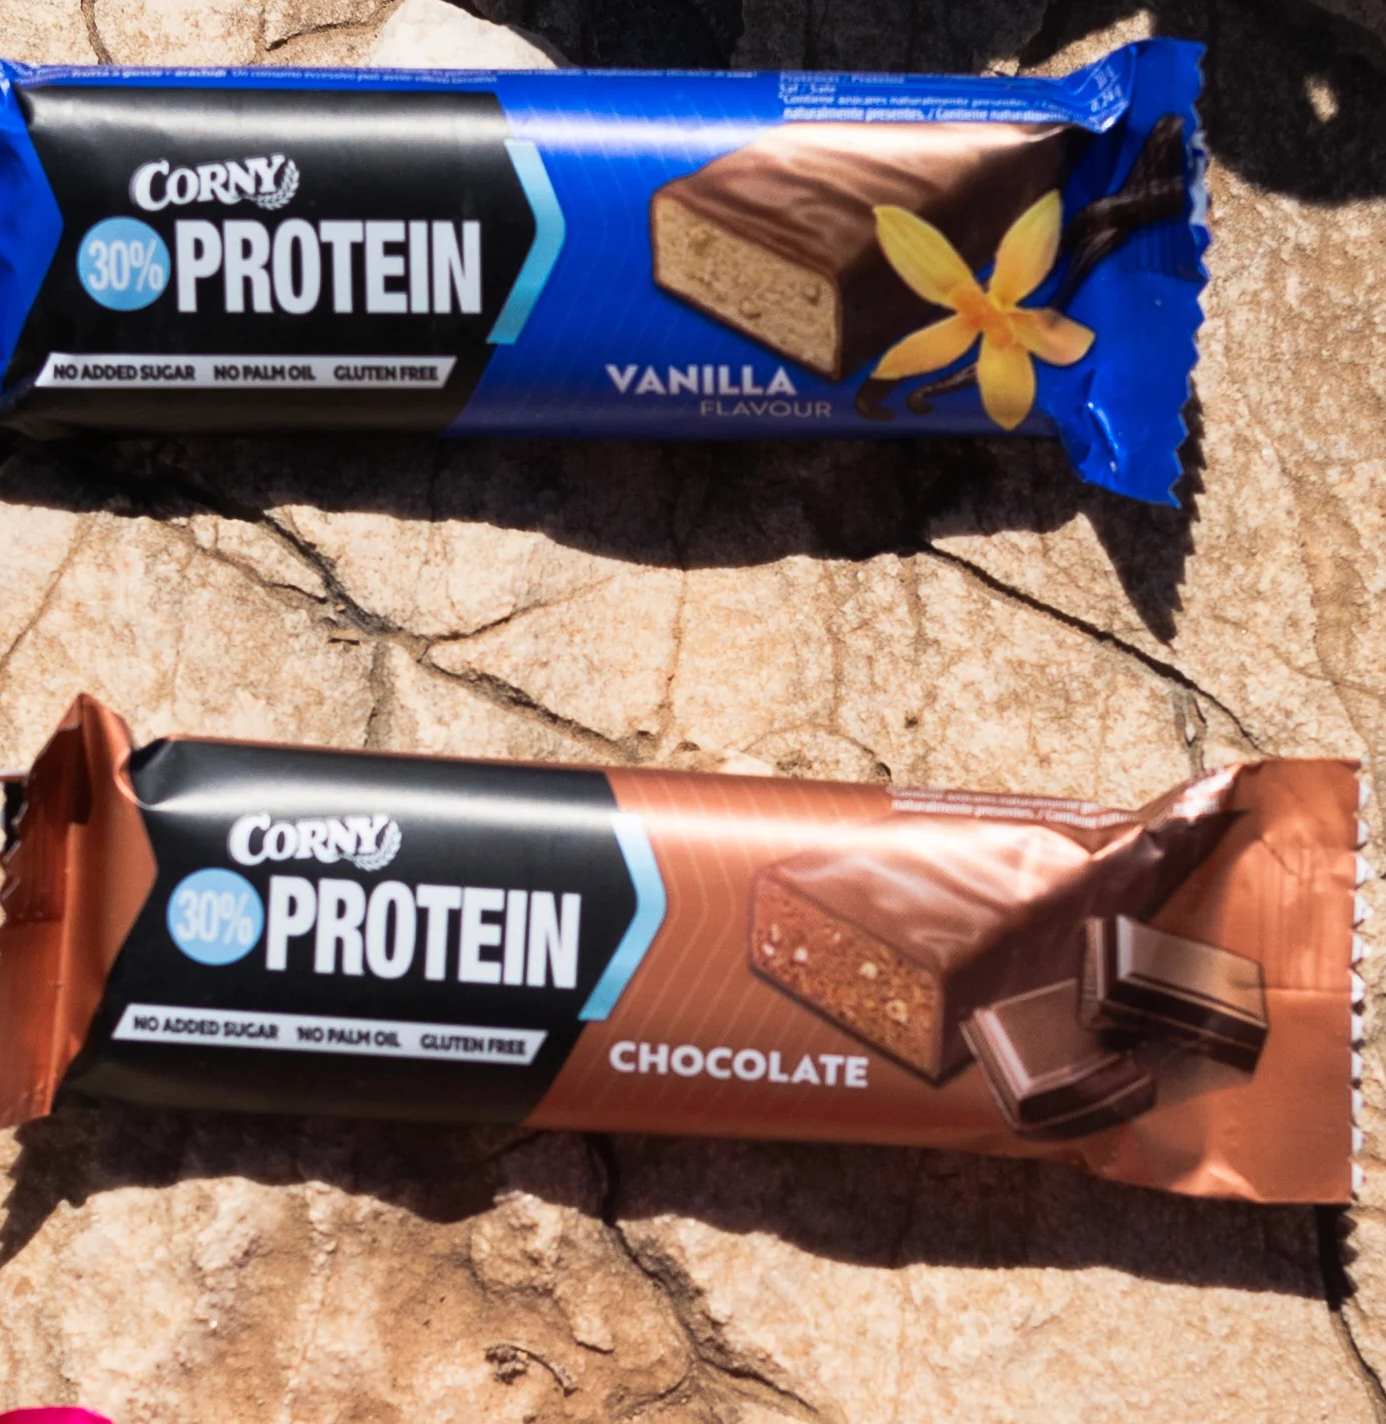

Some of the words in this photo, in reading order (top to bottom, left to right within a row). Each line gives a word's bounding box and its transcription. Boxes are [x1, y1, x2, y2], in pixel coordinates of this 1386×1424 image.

[130, 153, 288, 211] CORNY
[87, 239, 164, 292] 30%
[174, 217, 483, 315] PROTEIN
[53, 364, 79, 381] NO
[81, 364, 139, 382] ADDED
[140, 364, 196, 382] SUGAR
[213, 365, 236, 382] NO
[237, 365, 287, 382] PALM
[288, 365, 317, 382] OIL
[333, 365, 399, 382] GLUTEN
[400, 365, 439, 382] FREE
[607, 364, 798, 396] VANILLA
[700, 399, 832, 419] FLAVOUR
[226, 813, 390, 867] CORNY
[176, 889, 254, 947] 30%
[265, 875, 582, 989] PROTEIN
[133, 1014, 160, 1034] NO
[162, 1017, 220, 1037] ADDED
[222, 1020, 281, 1041] SUGAR
[296, 1025, 324, 1045] NO
[326, 1027, 373, 1047] PALM
[375, 1030, 403, 1049] OIL
[419, 1033, 485, 1054] GLUTEN
[487, 1037, 527, 1056] FREE
[610, 1039, 869, 1088] CHOCOLATE
